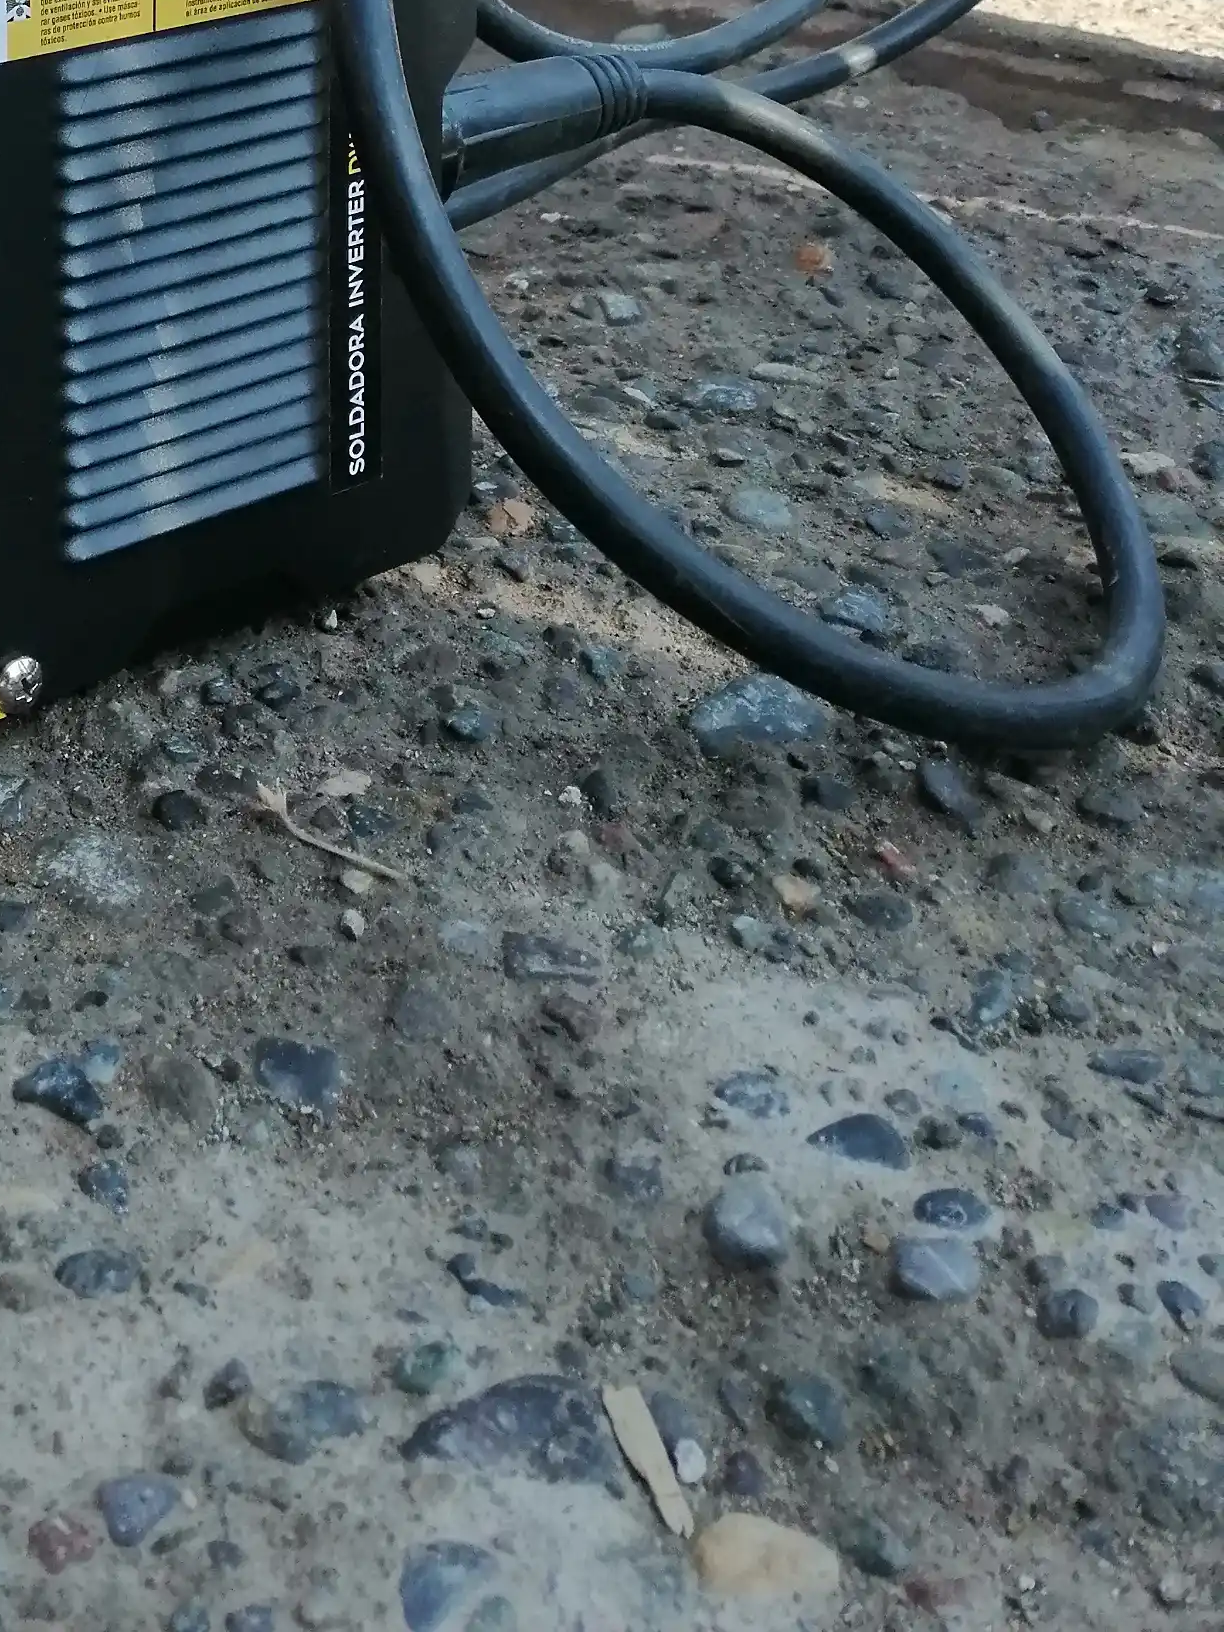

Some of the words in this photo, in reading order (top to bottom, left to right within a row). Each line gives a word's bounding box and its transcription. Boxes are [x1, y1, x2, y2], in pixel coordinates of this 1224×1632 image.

[40, 17, 49, 26] rar
[51, 14, 70, 25] gases
[104, 5, 115, 13] Use
[50, 0, 85, 13] ventilación
[87, 0, 90, 8] y
[209, 4, 216, 12] de
[40, 27, 50, 36] ras
[52, 25, 60, 33] de
[62, 18, 95, 33] protección
[97, 14, 116, 24] contra
[348, 178, 366, 308] INVERTER
[348, 313, 366, 476] SOLDADORA
